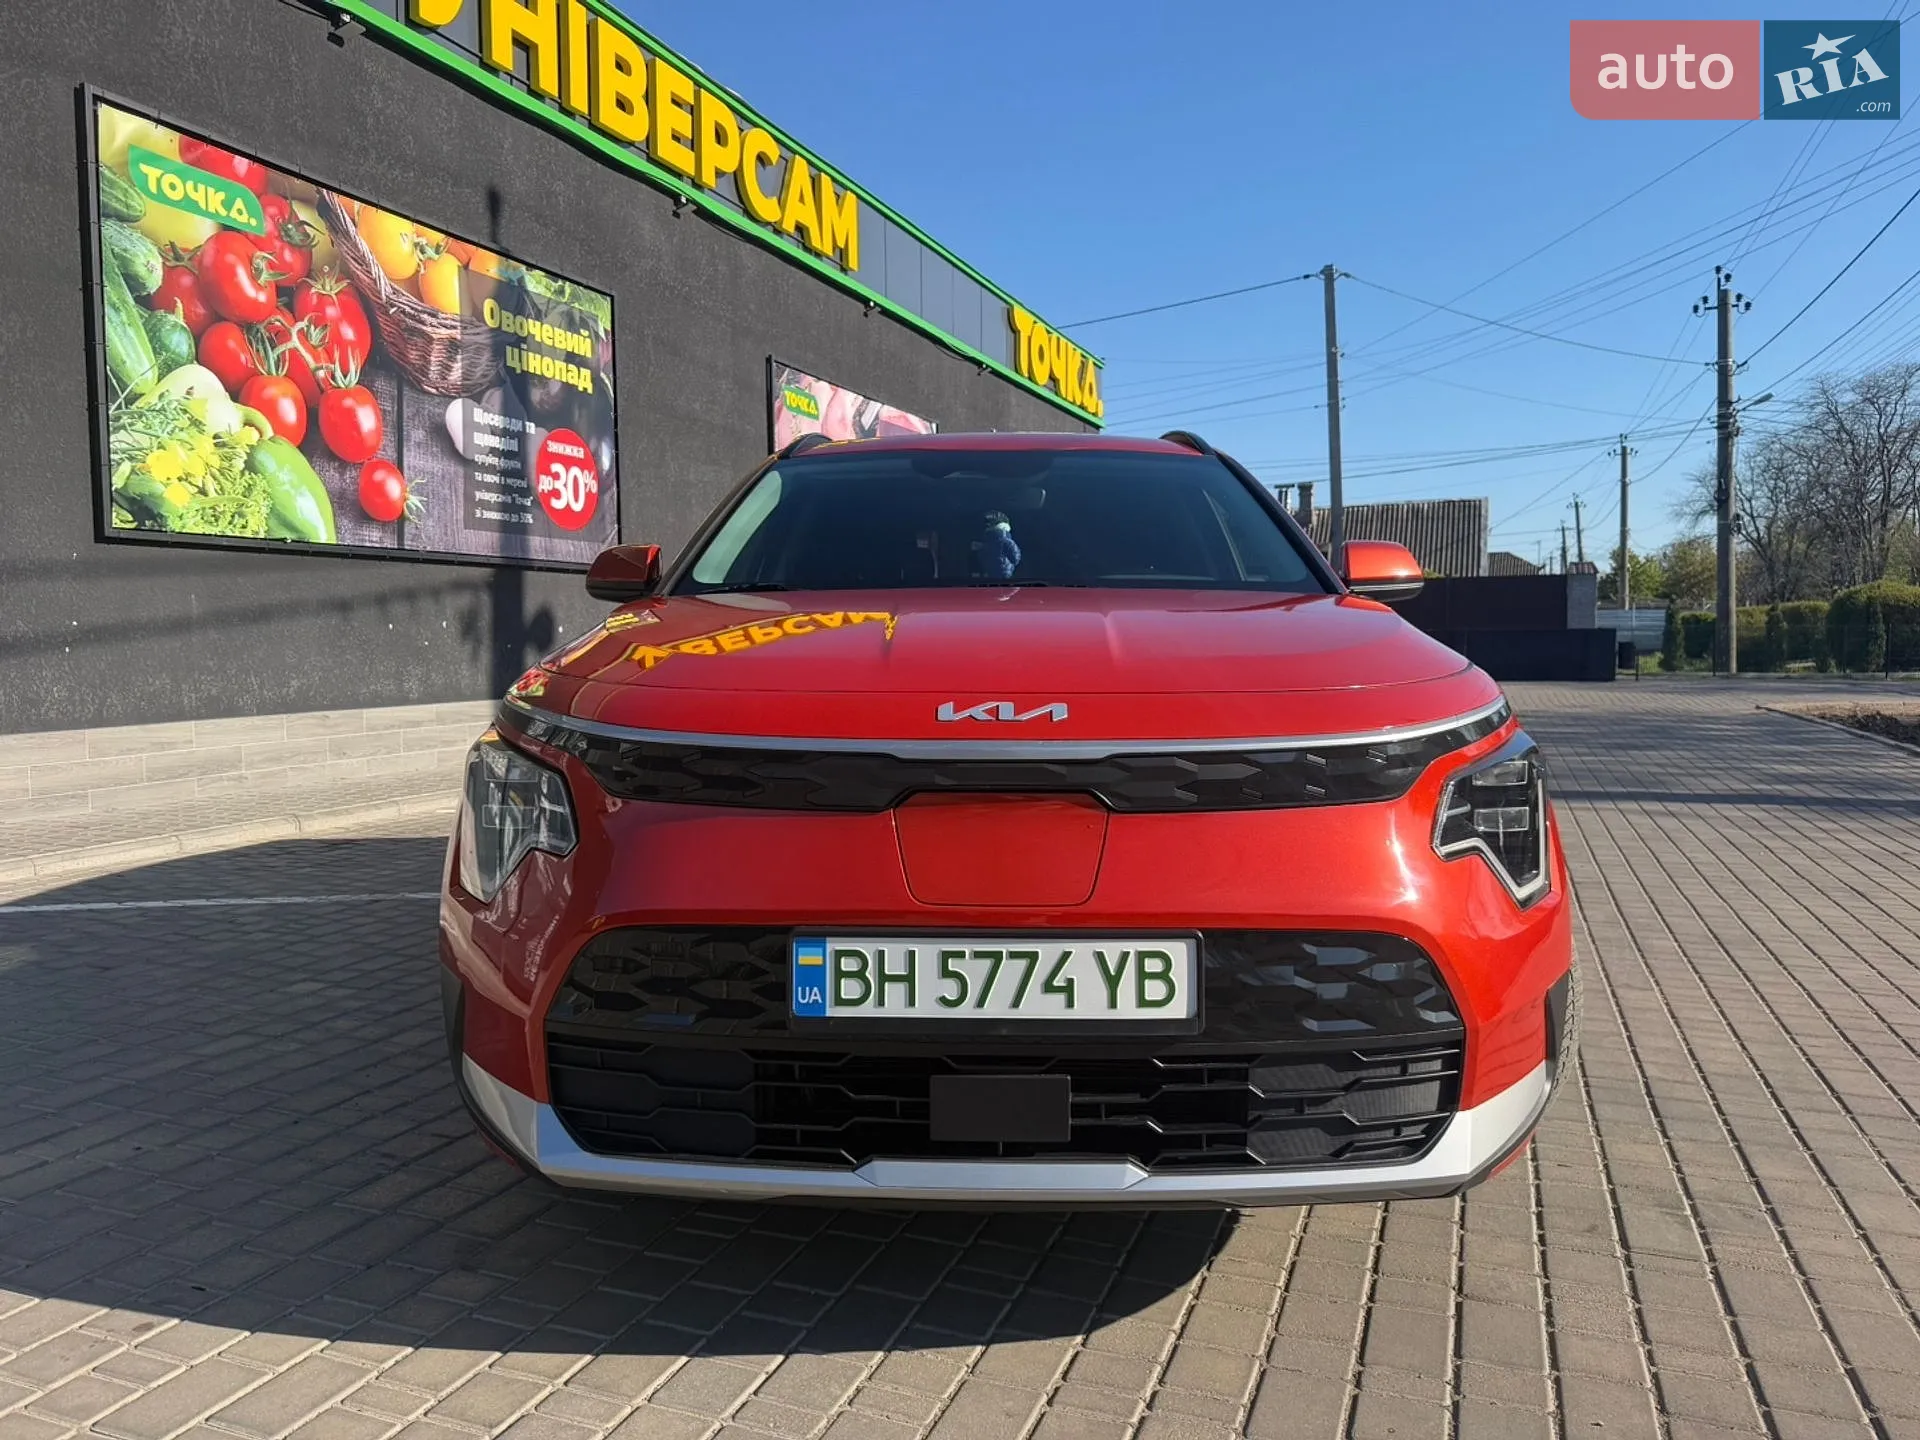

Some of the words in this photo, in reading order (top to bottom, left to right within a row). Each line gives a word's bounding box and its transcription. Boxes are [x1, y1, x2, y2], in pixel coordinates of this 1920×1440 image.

[409, 0, 860, 272] НІВЕРСАМ
[797, 986, 823, 1004] UA
[831, 948, 919, 1008] BH
[935, 949, 1078, 1009] 5774
[1092, 949, 1178, 1009] YB
